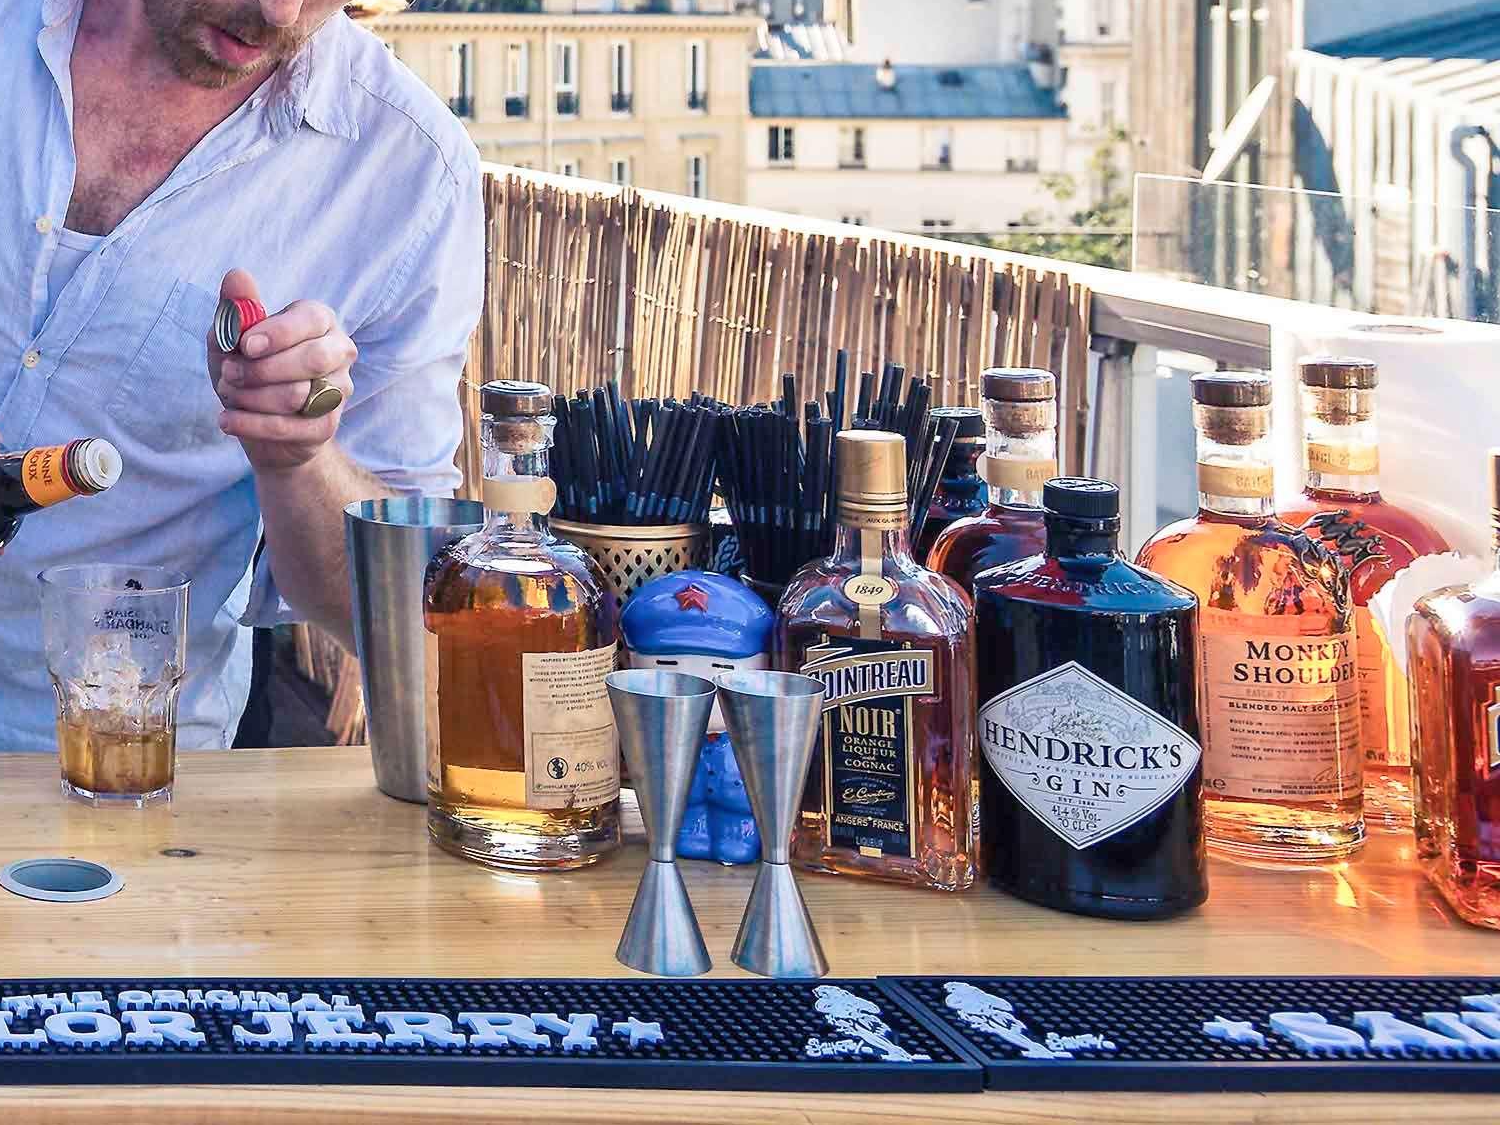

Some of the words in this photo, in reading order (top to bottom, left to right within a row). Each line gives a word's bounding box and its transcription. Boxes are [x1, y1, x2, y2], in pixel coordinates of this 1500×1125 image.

[854, 584, 884, 596] 1849
[1245, 639, 1350, 662] MONKEY
[1228, 701, 1278, 712] BLENDED
[1282, 703, 1308, 713] MALT
[838, 706, 897, 739] NOIR
[842, 745, 898, 759] LIQUEUR
[844, 736, 893, 749] ORANGE
[984, 719, 1182, 770] HENDRICK'S
[844, 758, 895, 772] COGNAC
[1045, 774, 1111, 798] GIN
[835, 814, 869, 827] ANGERS
[872, 820, 905, 833] FRANCE
[0, 989, 112, 1016] THE
[117, 988, 362, 1016] ORIGINAL
[231, 1010, 600, 1052] JERRY
